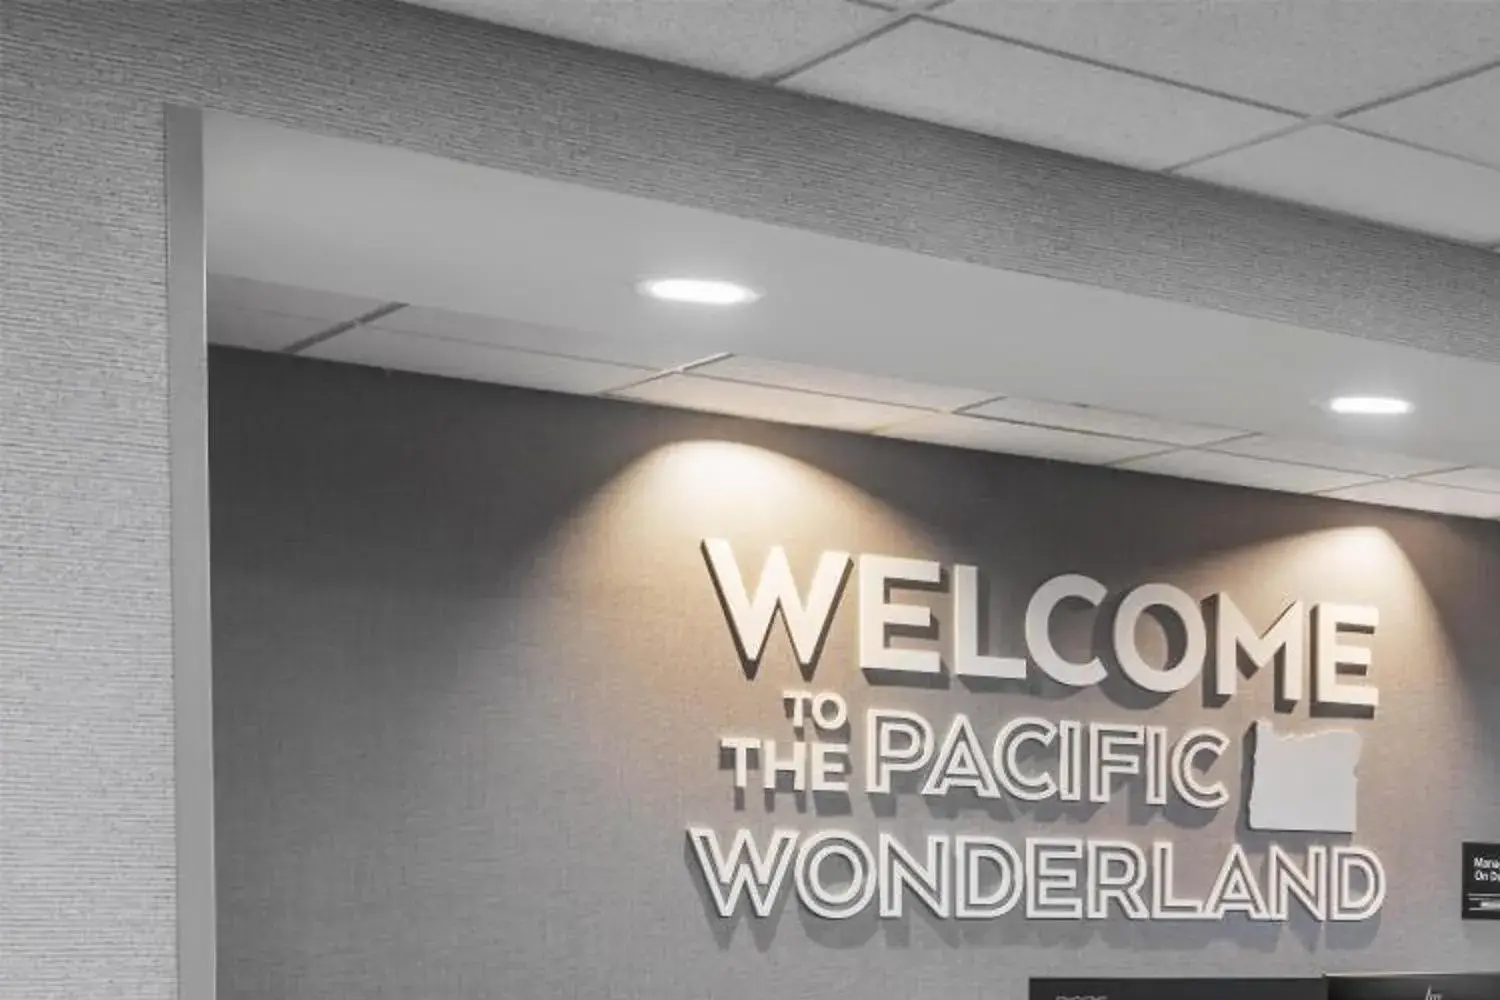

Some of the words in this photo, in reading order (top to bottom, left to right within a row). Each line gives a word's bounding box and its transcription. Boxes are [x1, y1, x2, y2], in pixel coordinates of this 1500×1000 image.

[701, 536, 1380, 706] WELCOME
[783, 689, 848, 730] TO
[720, 737, 849, 791] THE
[864, 707, 1231, 810] PACIFIC
[688, 827, 1386, 922] WONDERLAND
[1473, 870, 1489, 881] On
